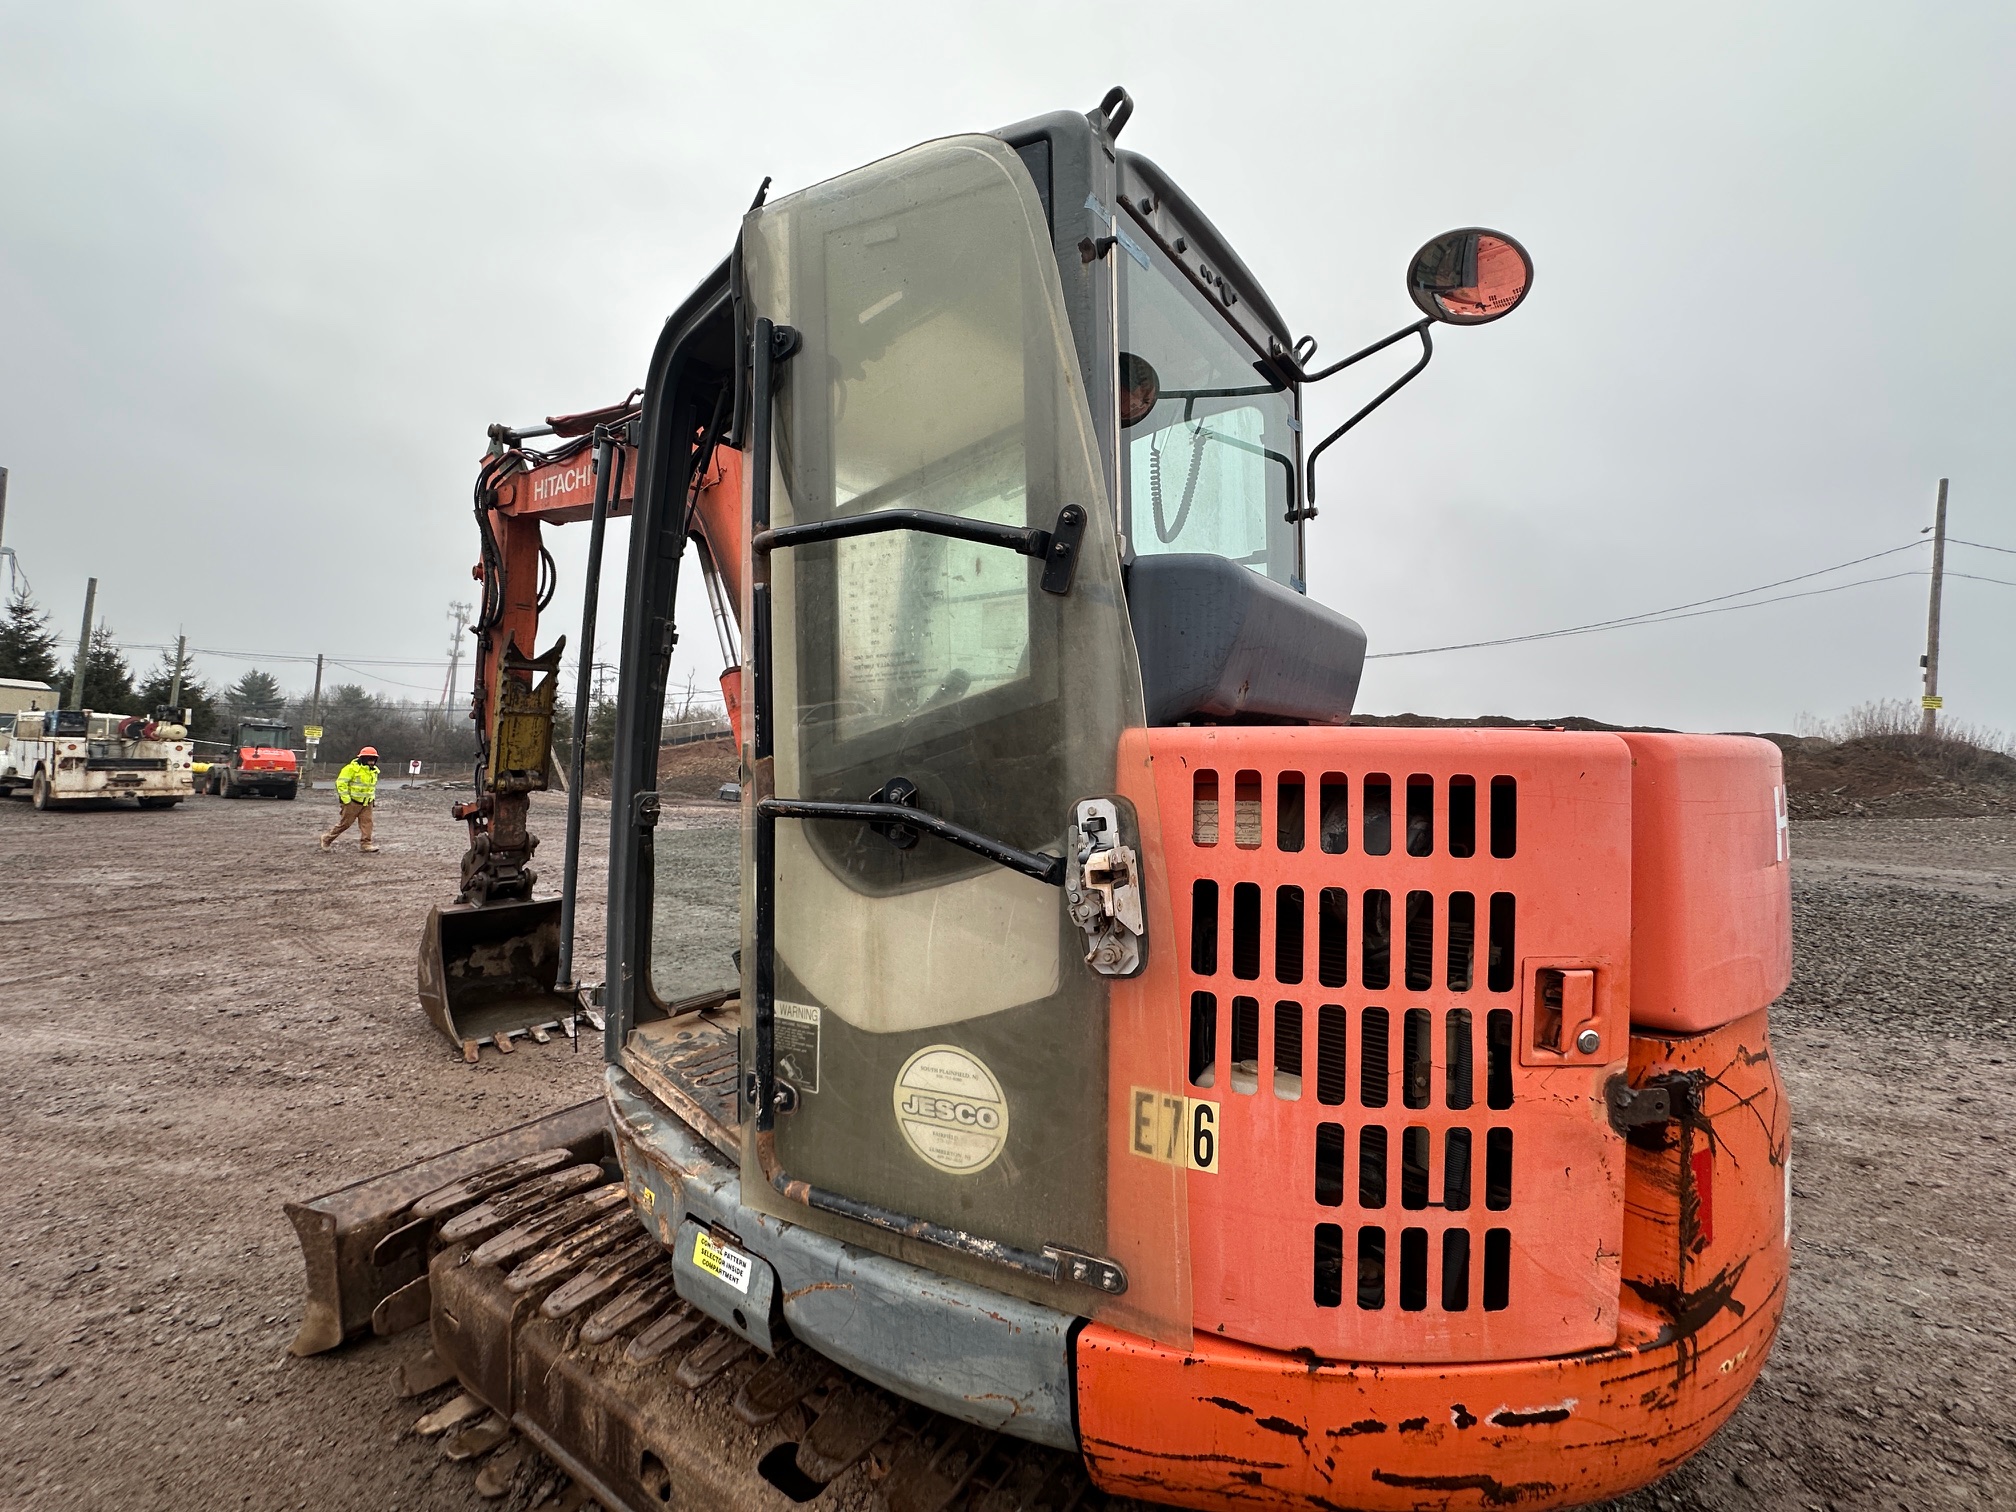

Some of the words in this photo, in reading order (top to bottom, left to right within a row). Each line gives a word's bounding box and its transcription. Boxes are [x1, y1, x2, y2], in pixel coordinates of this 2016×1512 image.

[534, 465, 591, 501] HITACHI
[780, 1003, 818, 1021] WARNING
[902, 1094, 999, 1130] JESCO
[1134, 1091, 1214, 1168] E76
[701, 1248, 725, 1267] SELECTOR
[726, 1261, 744, 1277] INSIDE
[702, 1259, 739, 1284] COMPARTMENT
[723, 1251, 747, 1268] PATTERN
